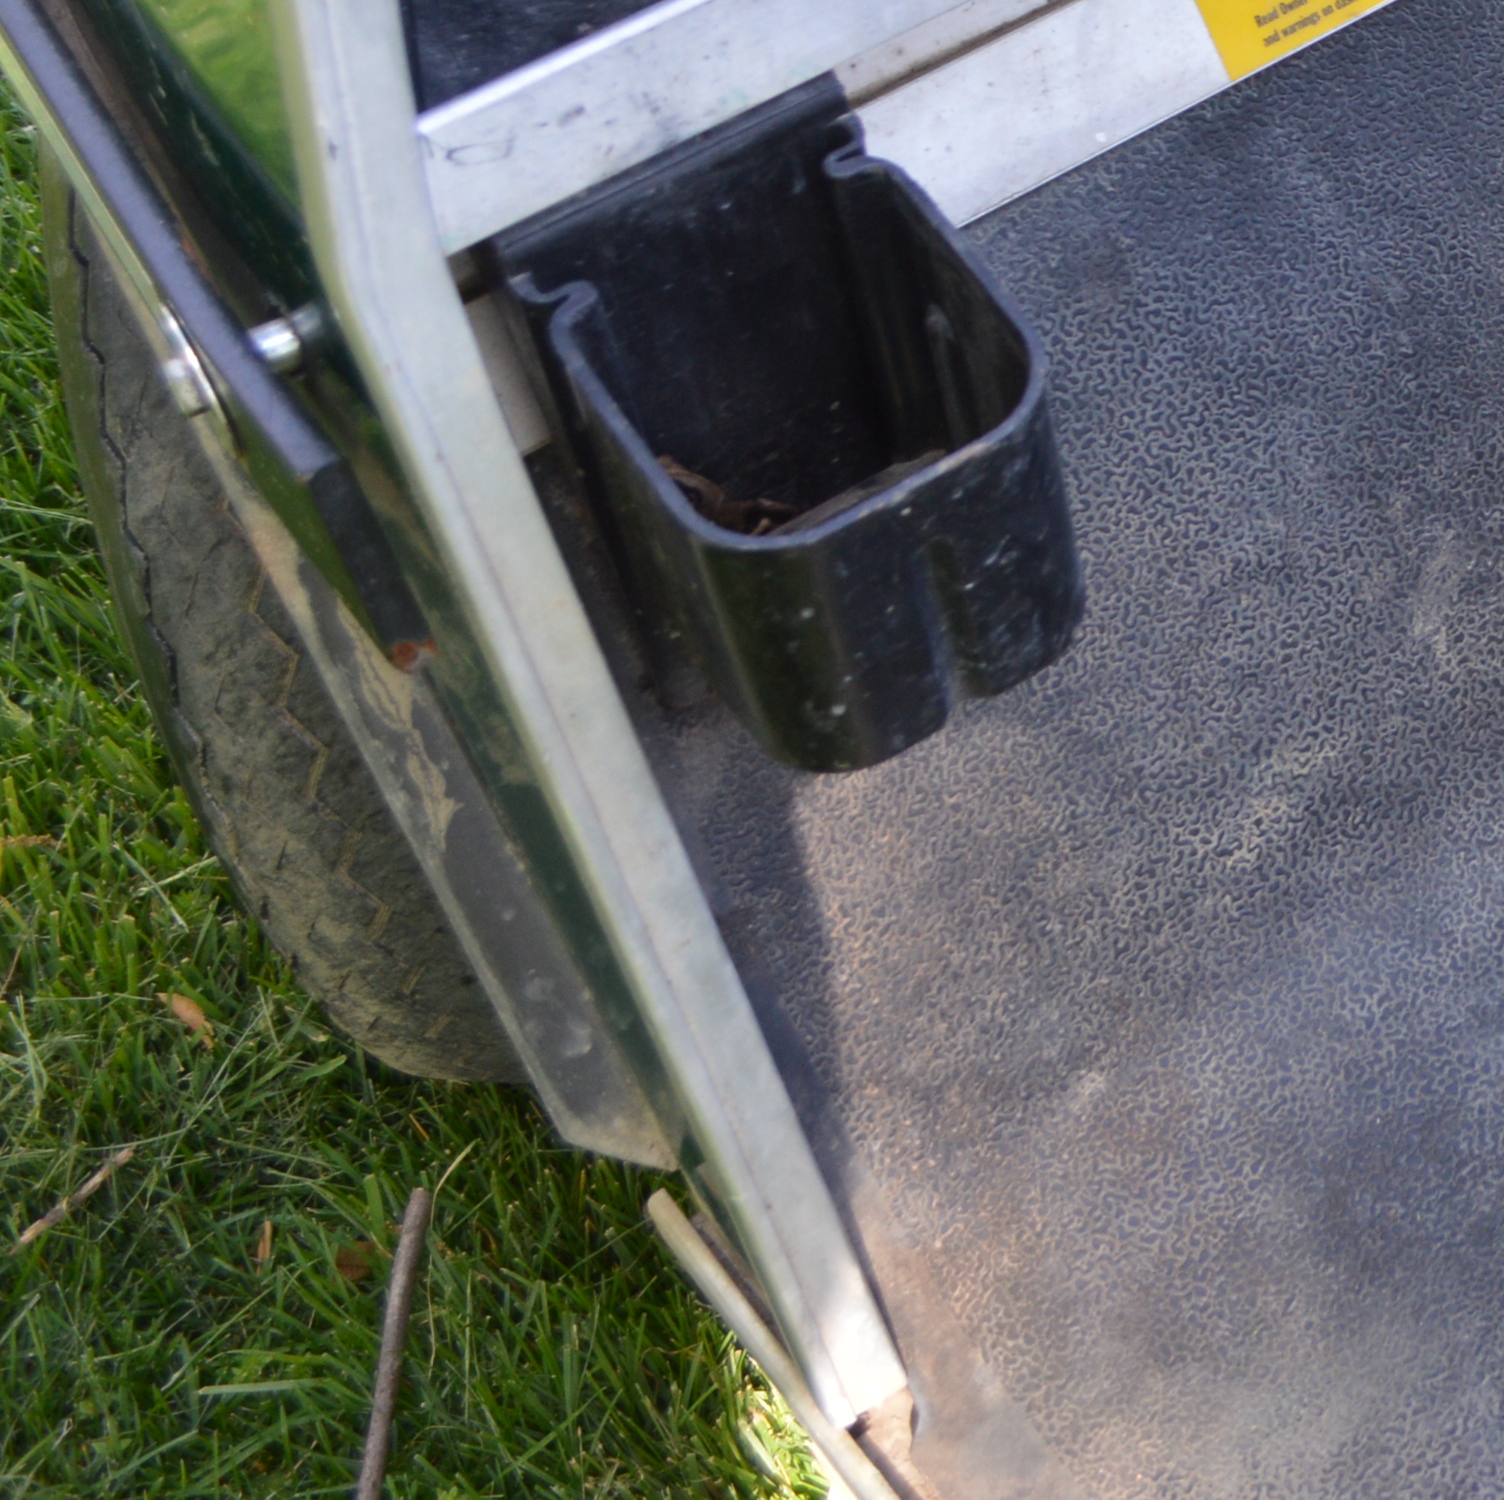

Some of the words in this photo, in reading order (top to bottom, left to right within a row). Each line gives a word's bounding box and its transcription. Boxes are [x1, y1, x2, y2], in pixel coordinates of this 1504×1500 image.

[1253, 8, 1279, 27] Read
[1262, 28, 1281, 47] and
[1280, 10, 1321, 37] warnings
[1320, 3, 1335, 17] on
